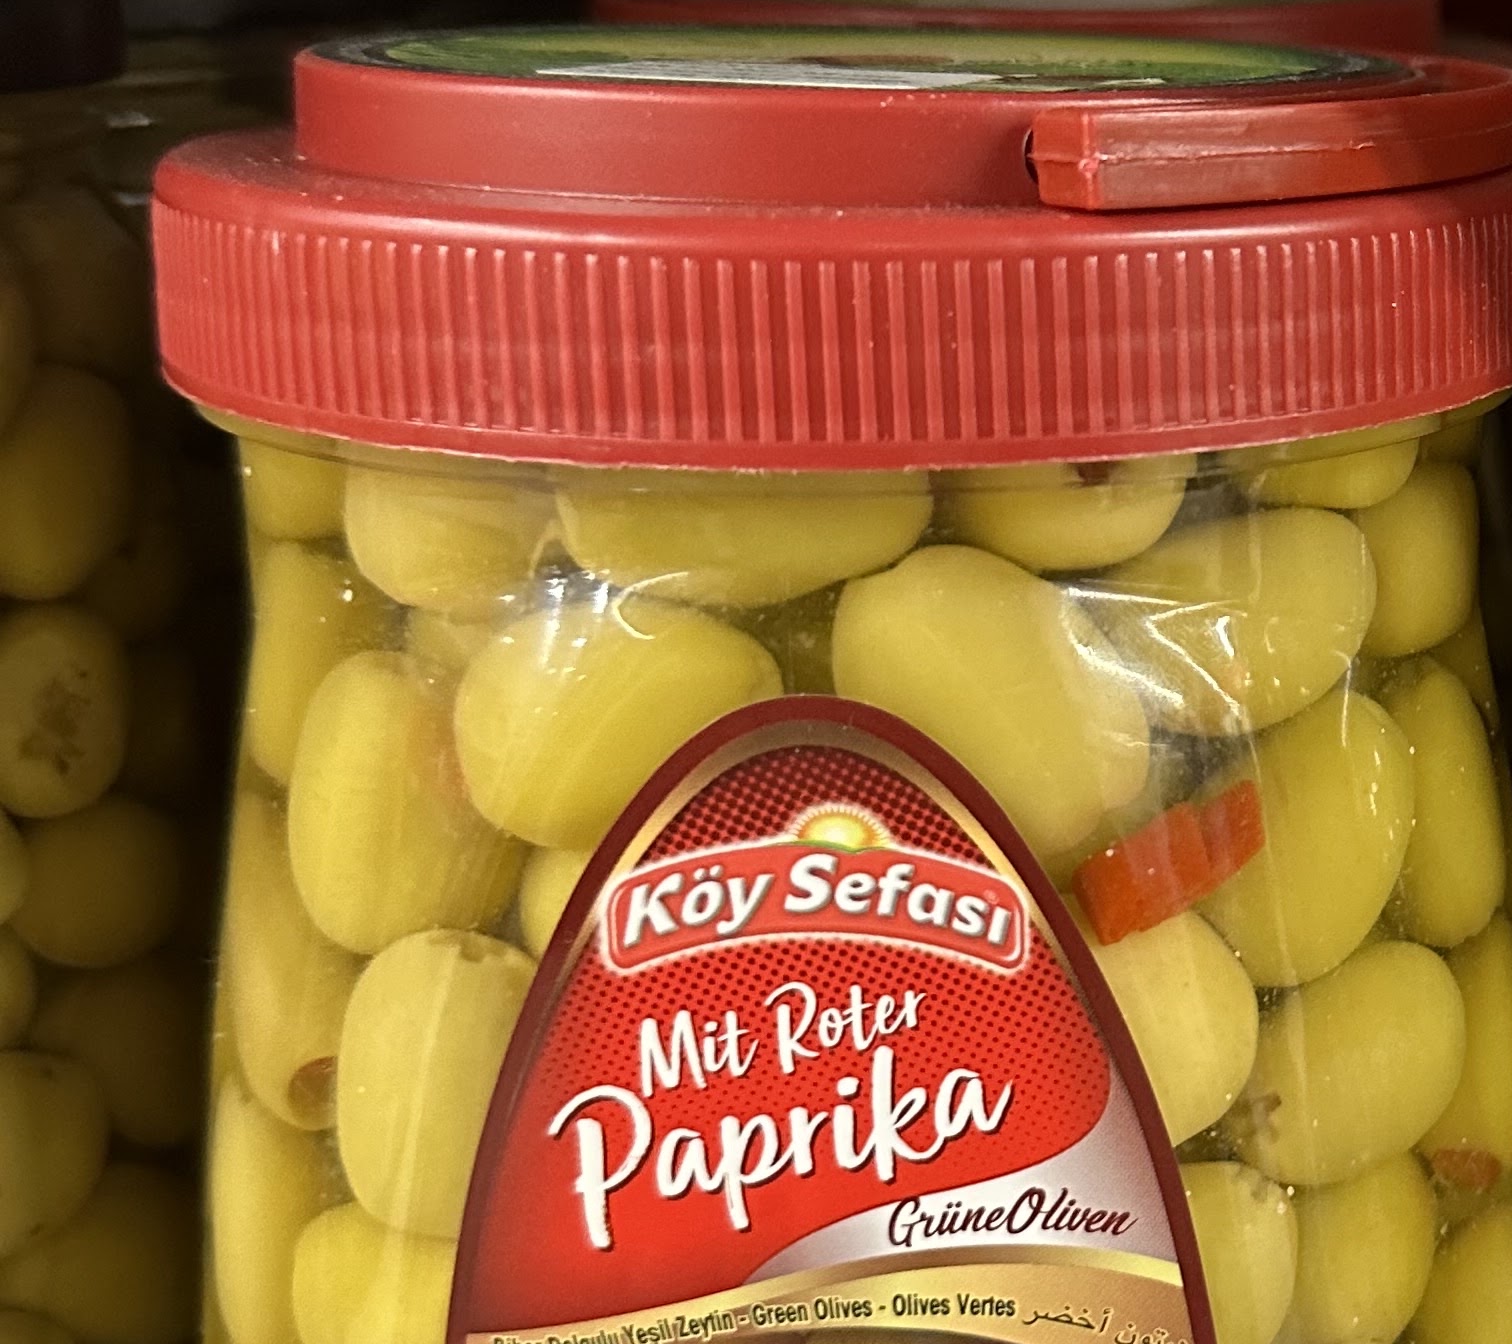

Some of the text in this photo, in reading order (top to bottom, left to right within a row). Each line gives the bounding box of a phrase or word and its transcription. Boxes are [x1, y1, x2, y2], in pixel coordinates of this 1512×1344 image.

[620, 861, 772, 947] Köy
[639, 982, 928, 1098] Mit Roter
[548, 1046, 1016, 1251] Paprika
[677, 1310, 735, 1340] Zeytin
[751, 1302, 808, 1326] Green
[814, 1296, 872, 1320] Olives
[892, 1294, 950, 1316] Olives
[957, 1294, 1016, 1316] Vertes
